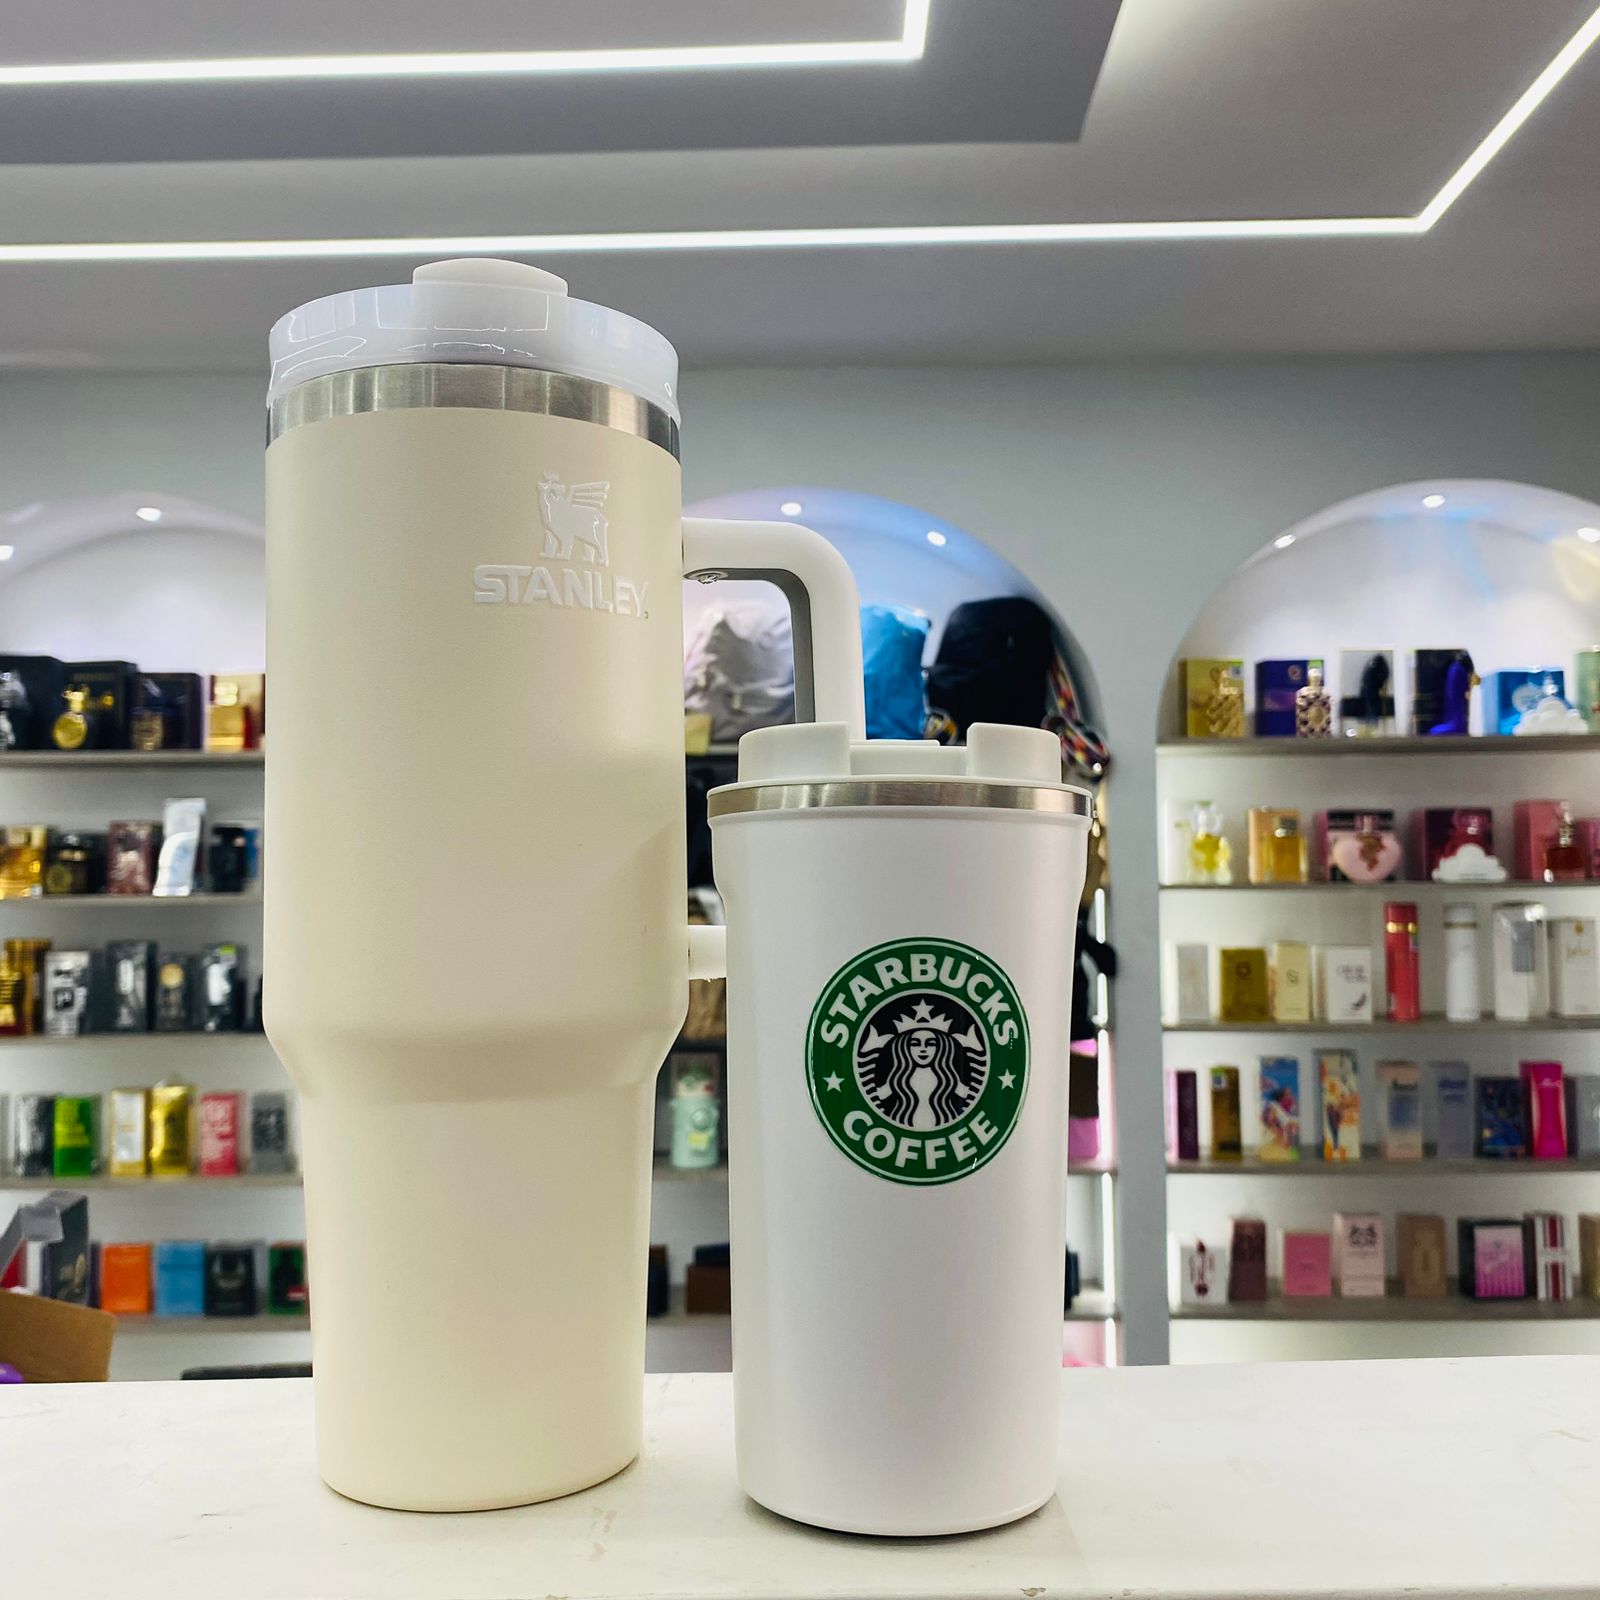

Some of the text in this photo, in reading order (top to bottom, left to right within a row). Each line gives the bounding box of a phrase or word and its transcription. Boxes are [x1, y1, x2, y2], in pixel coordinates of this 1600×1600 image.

[473, 564, 649, 617] STANLEY
[820, 953, 1019, 1048] STARBUCKS
[843, 1109, 999, 1170] COFFEE
